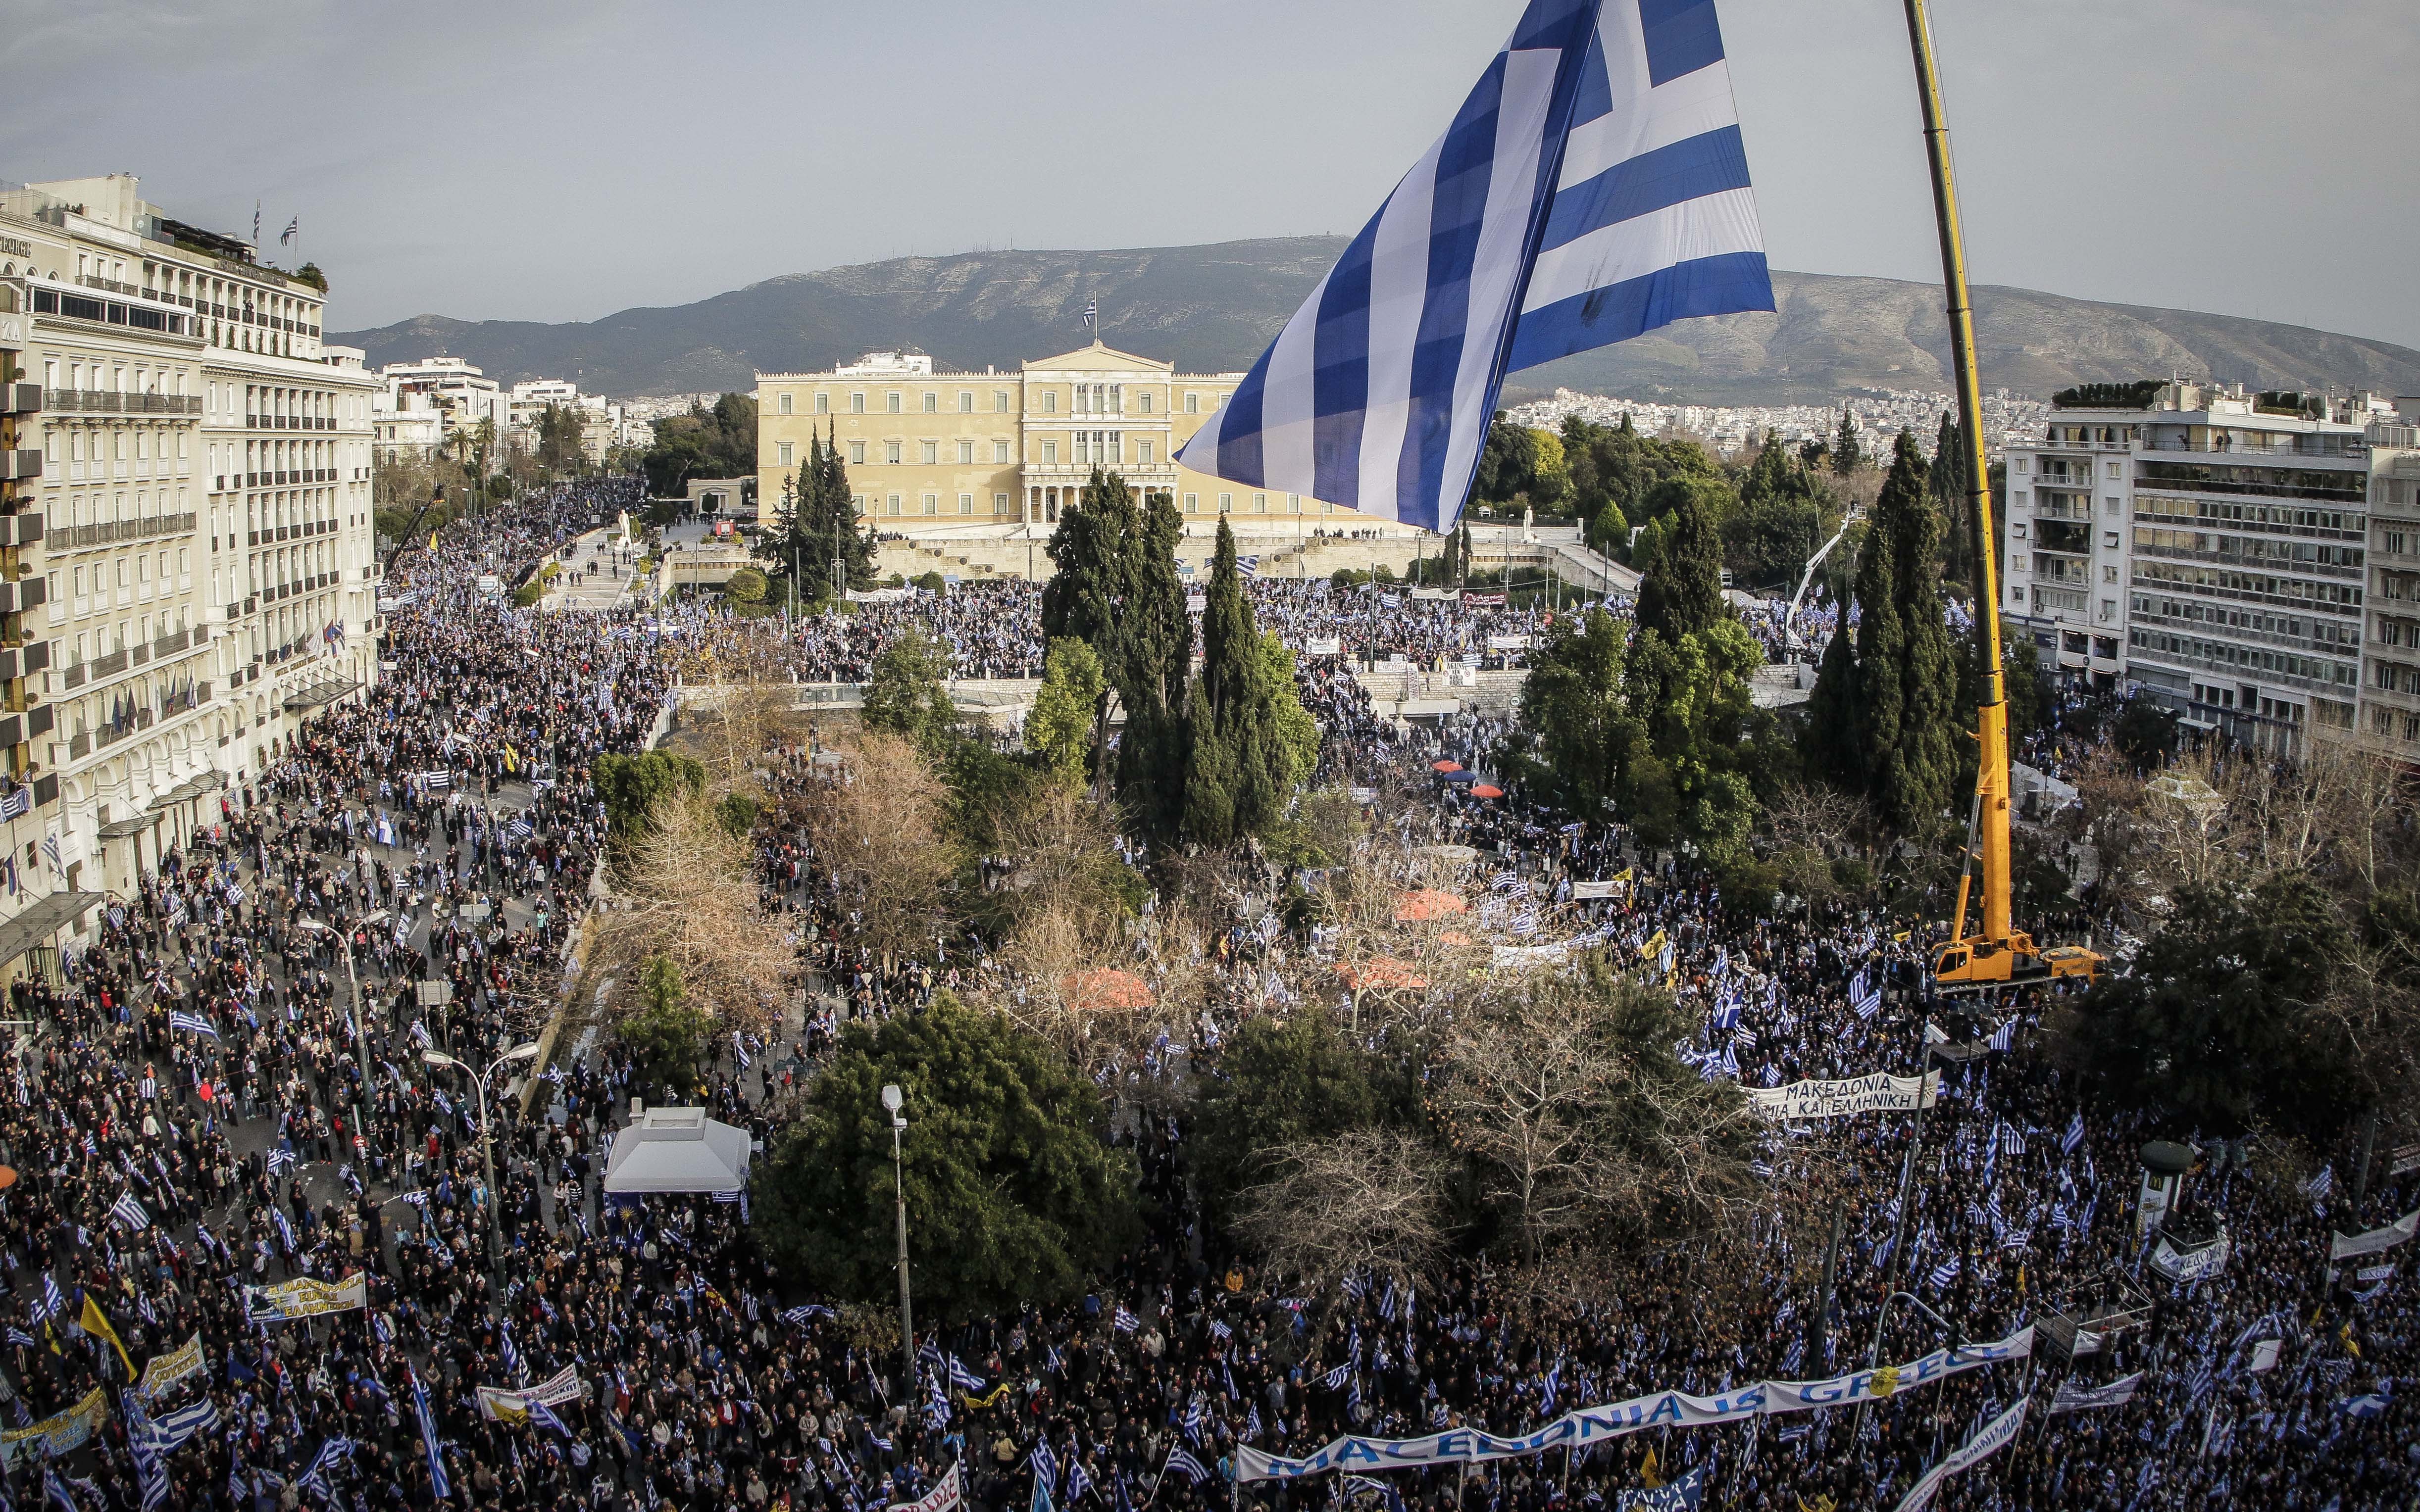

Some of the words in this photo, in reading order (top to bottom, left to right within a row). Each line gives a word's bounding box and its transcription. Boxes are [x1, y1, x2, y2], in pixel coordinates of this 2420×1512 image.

[284, 1275, 364, 1293] ΜΑΚΕΔΟΝΙΑ
[1267, 1394, 1683, 1476] MACEDONIA
[1714, 1388, 1766, 1413] IS
